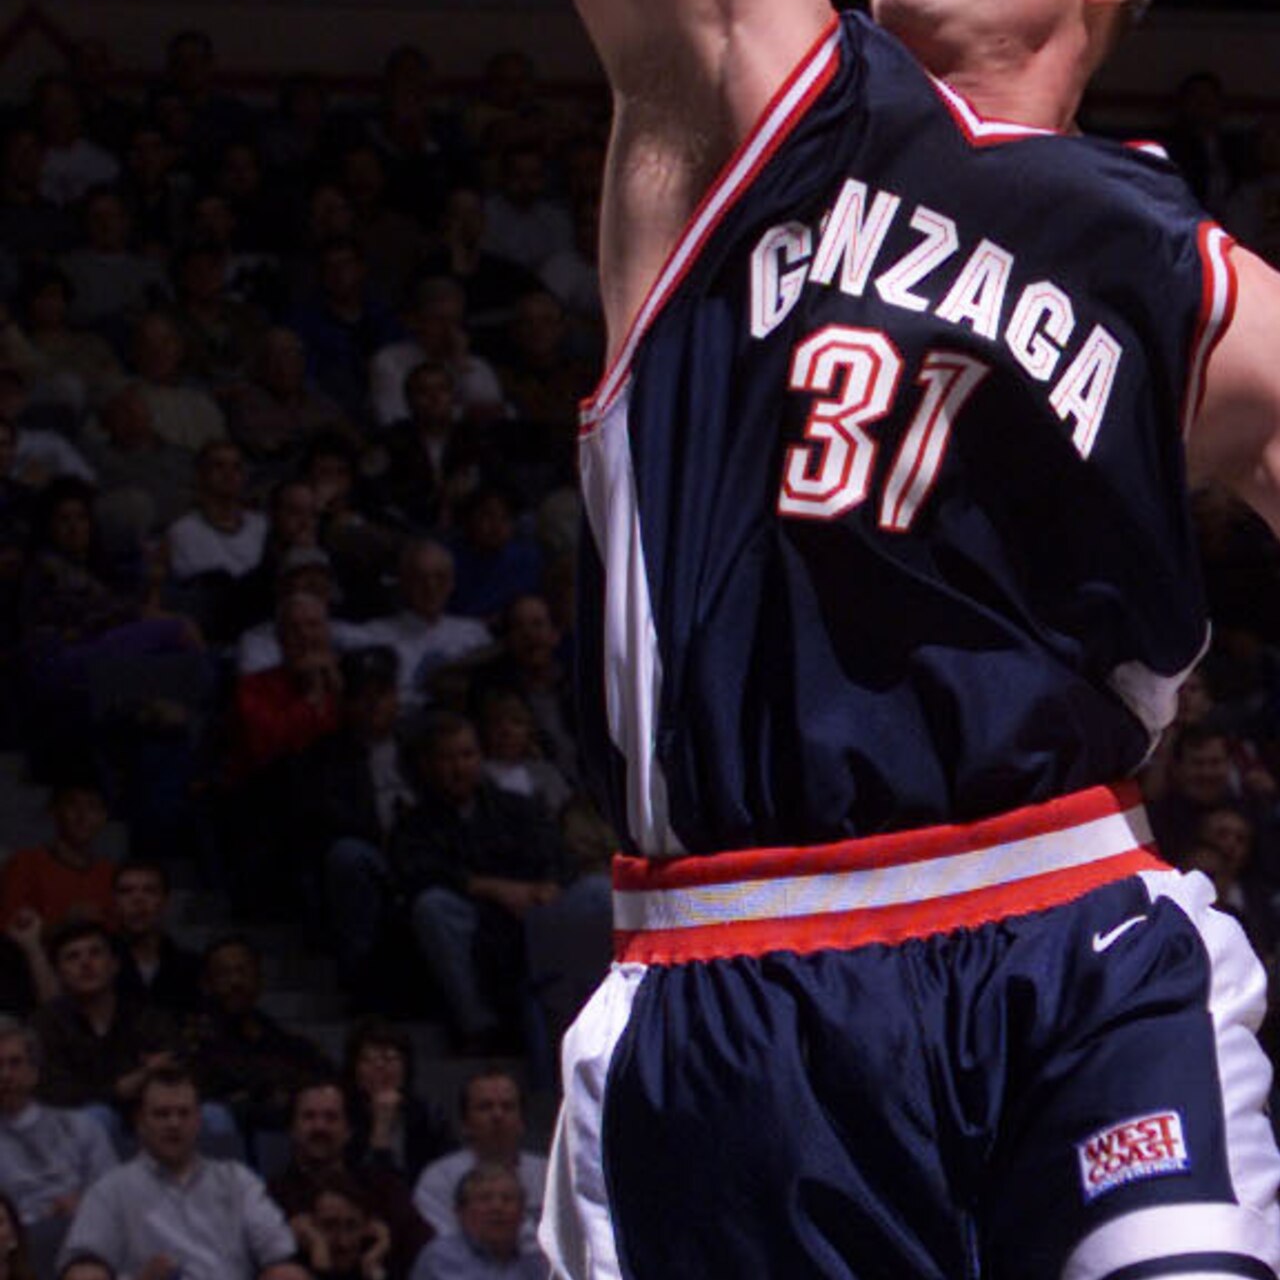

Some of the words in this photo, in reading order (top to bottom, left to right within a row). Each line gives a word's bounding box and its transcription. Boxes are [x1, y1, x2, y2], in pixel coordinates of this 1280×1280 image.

[750, 176, 1125, 463] GNZAGA
[776, 322, 993, 535] 31
[1086, 1114, 1176, 1161] WEST
